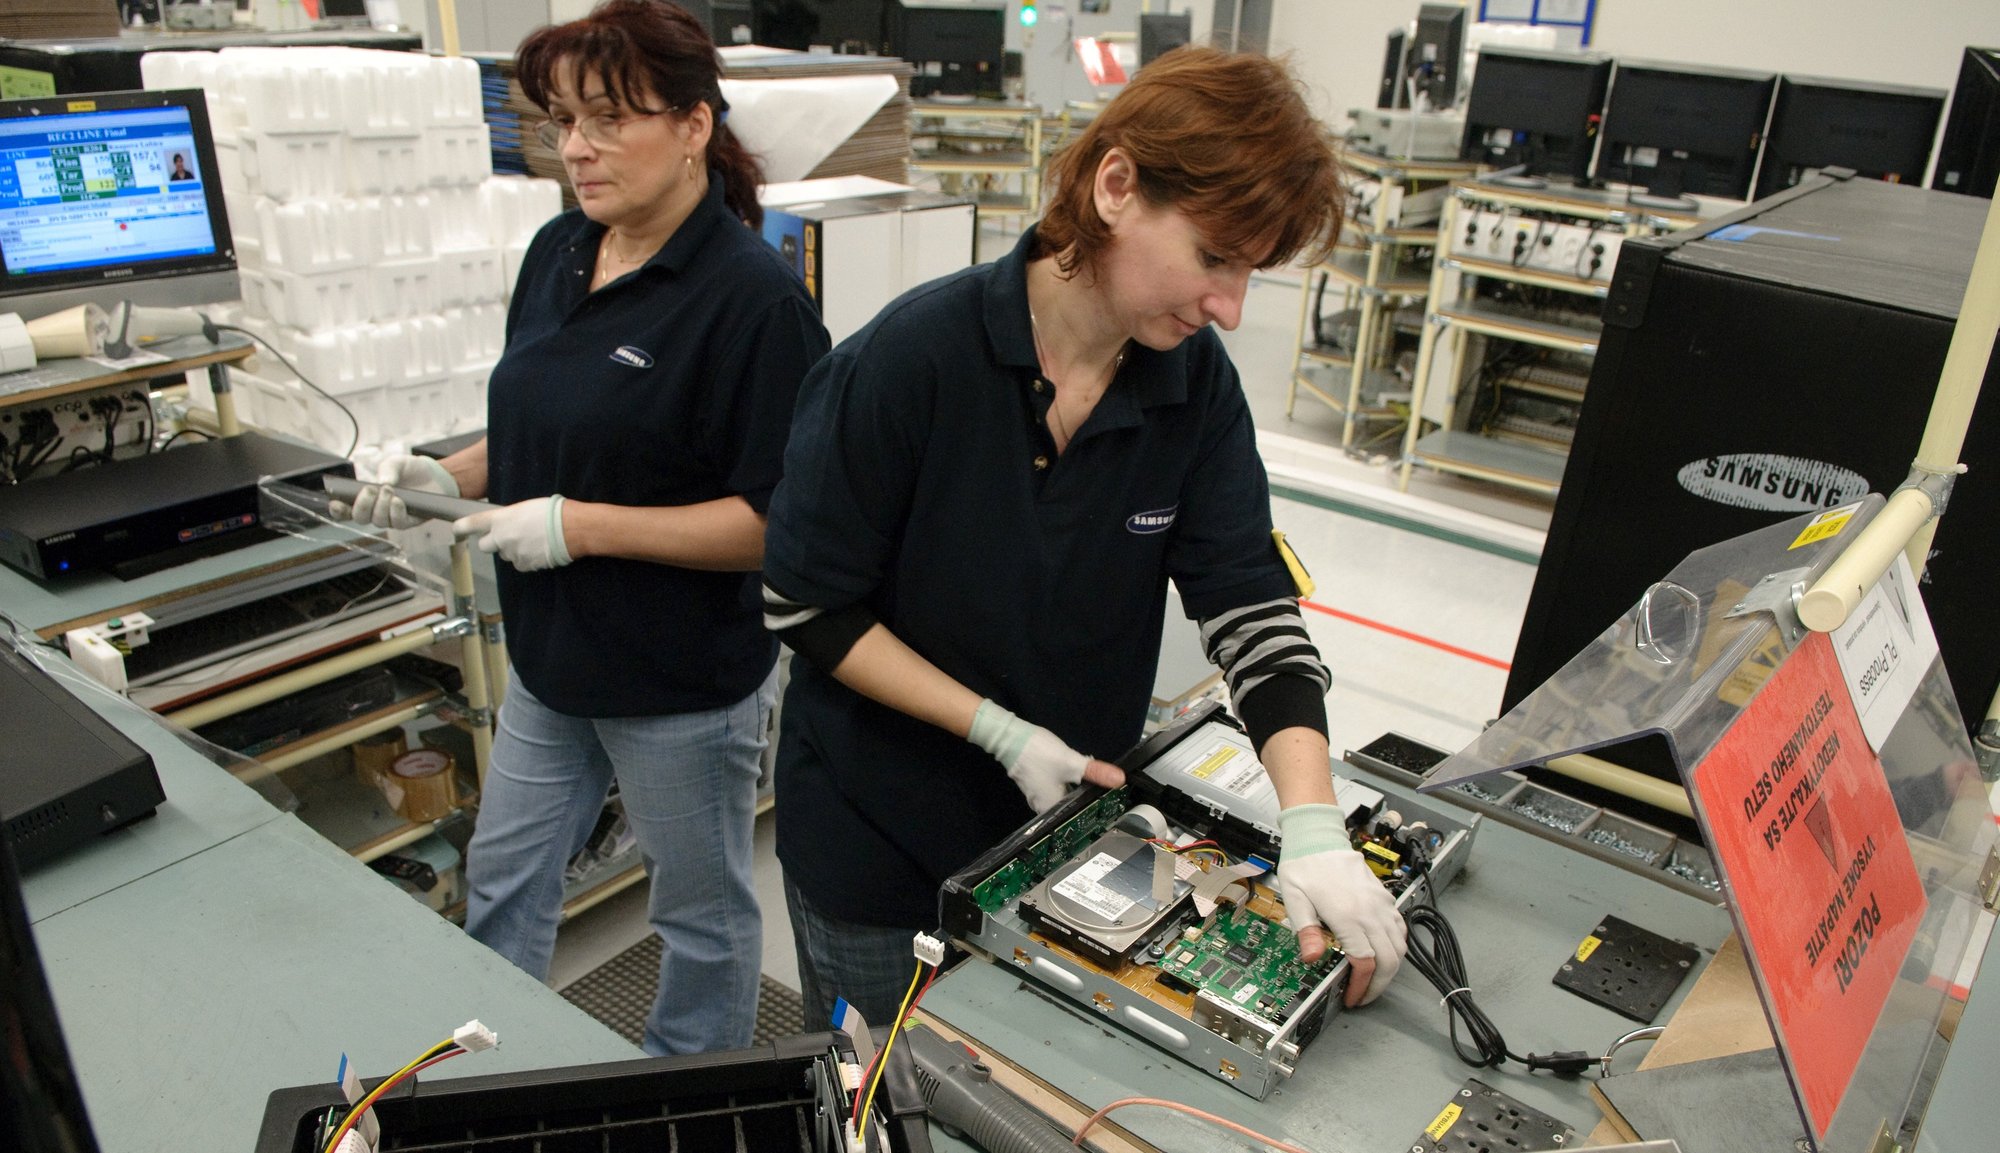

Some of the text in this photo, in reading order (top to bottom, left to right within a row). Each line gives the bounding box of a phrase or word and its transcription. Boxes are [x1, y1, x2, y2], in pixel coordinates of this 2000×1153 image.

[1703, 457, 1842, 508] SAMSUNG
[1134, 514, 1175, 525] SAMSU
[1859, 650, 1889, 696] Process
[1884, 637, 1898, 662] PL
[1744, 688, 1834, 823] TESTOVANÉHO SETU
[1763, 819, 1782, 852] SA
[1805, 835, 1876, 968] VYSOKÉ NAPÄTIE
[1833, 891, 1881, 995] POZOR!
